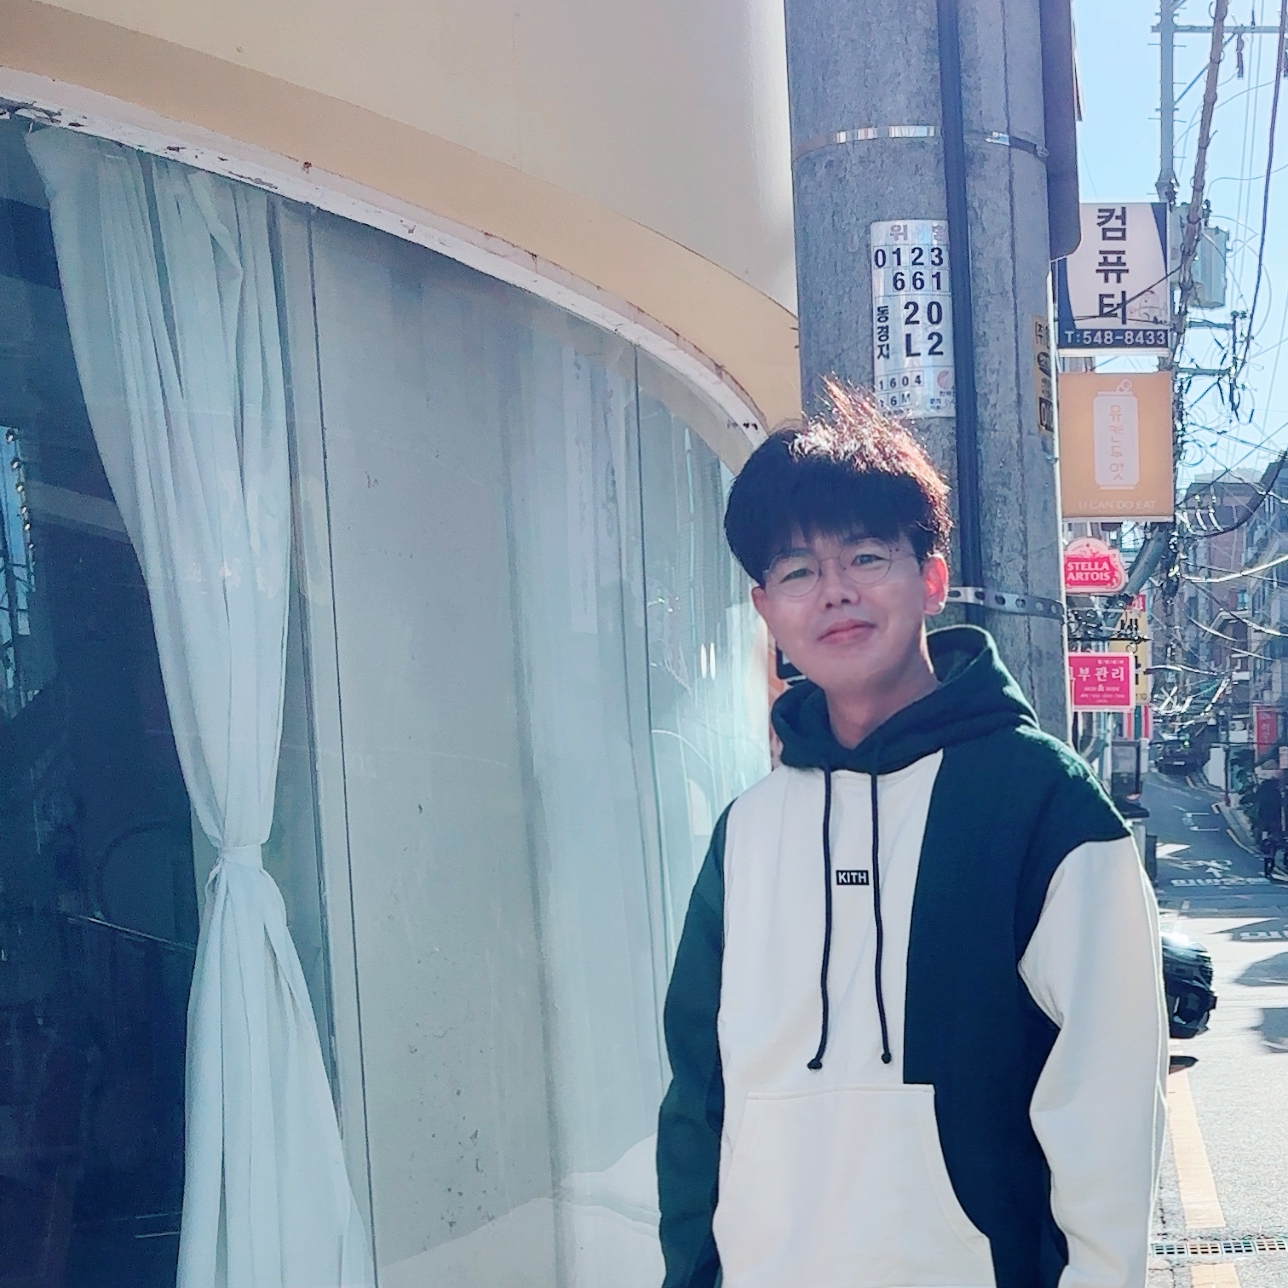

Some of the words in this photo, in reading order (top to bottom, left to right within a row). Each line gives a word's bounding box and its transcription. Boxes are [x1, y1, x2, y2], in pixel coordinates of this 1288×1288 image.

[1096, 206, 1129, 325] 컴퓨터
[892, 271, 942, 291] 661
[903, 301, 943, 325] 20
[905, 332, 944, 357] L2
[1065, 331, 1165, 345] T:548-8433
[1066, 561, 1110, 572] STELLA
[1066, 572, 1111, 582] ARTOIS
[838, 871, 868, 884] KITH
